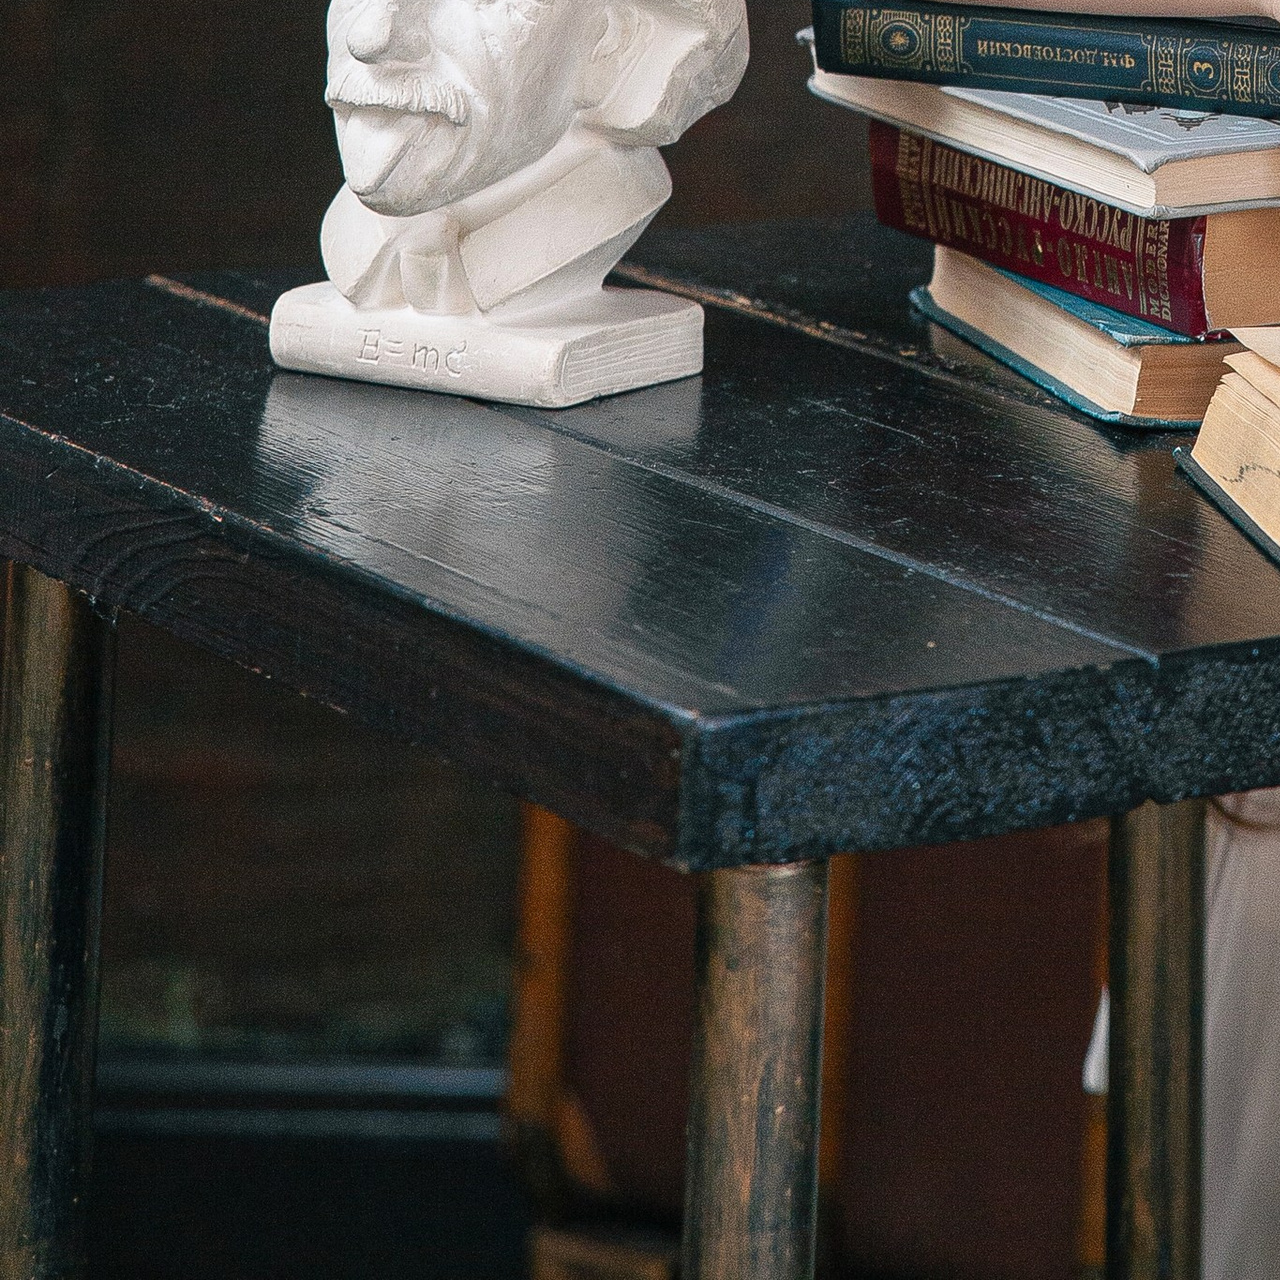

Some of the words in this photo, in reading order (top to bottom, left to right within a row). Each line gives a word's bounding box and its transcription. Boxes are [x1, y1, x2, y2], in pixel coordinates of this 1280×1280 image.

[977, 39, 1098, 66] ДОСТОЕВСКИЙ
[1193, 60, 1214, 80] 3
[933, 194, 1134, 301] АНГЛО-РУССКИЙ
[1145, 220, 1161, 318] MODER
[1156, 219, 1172, 322] DICTIONAR
